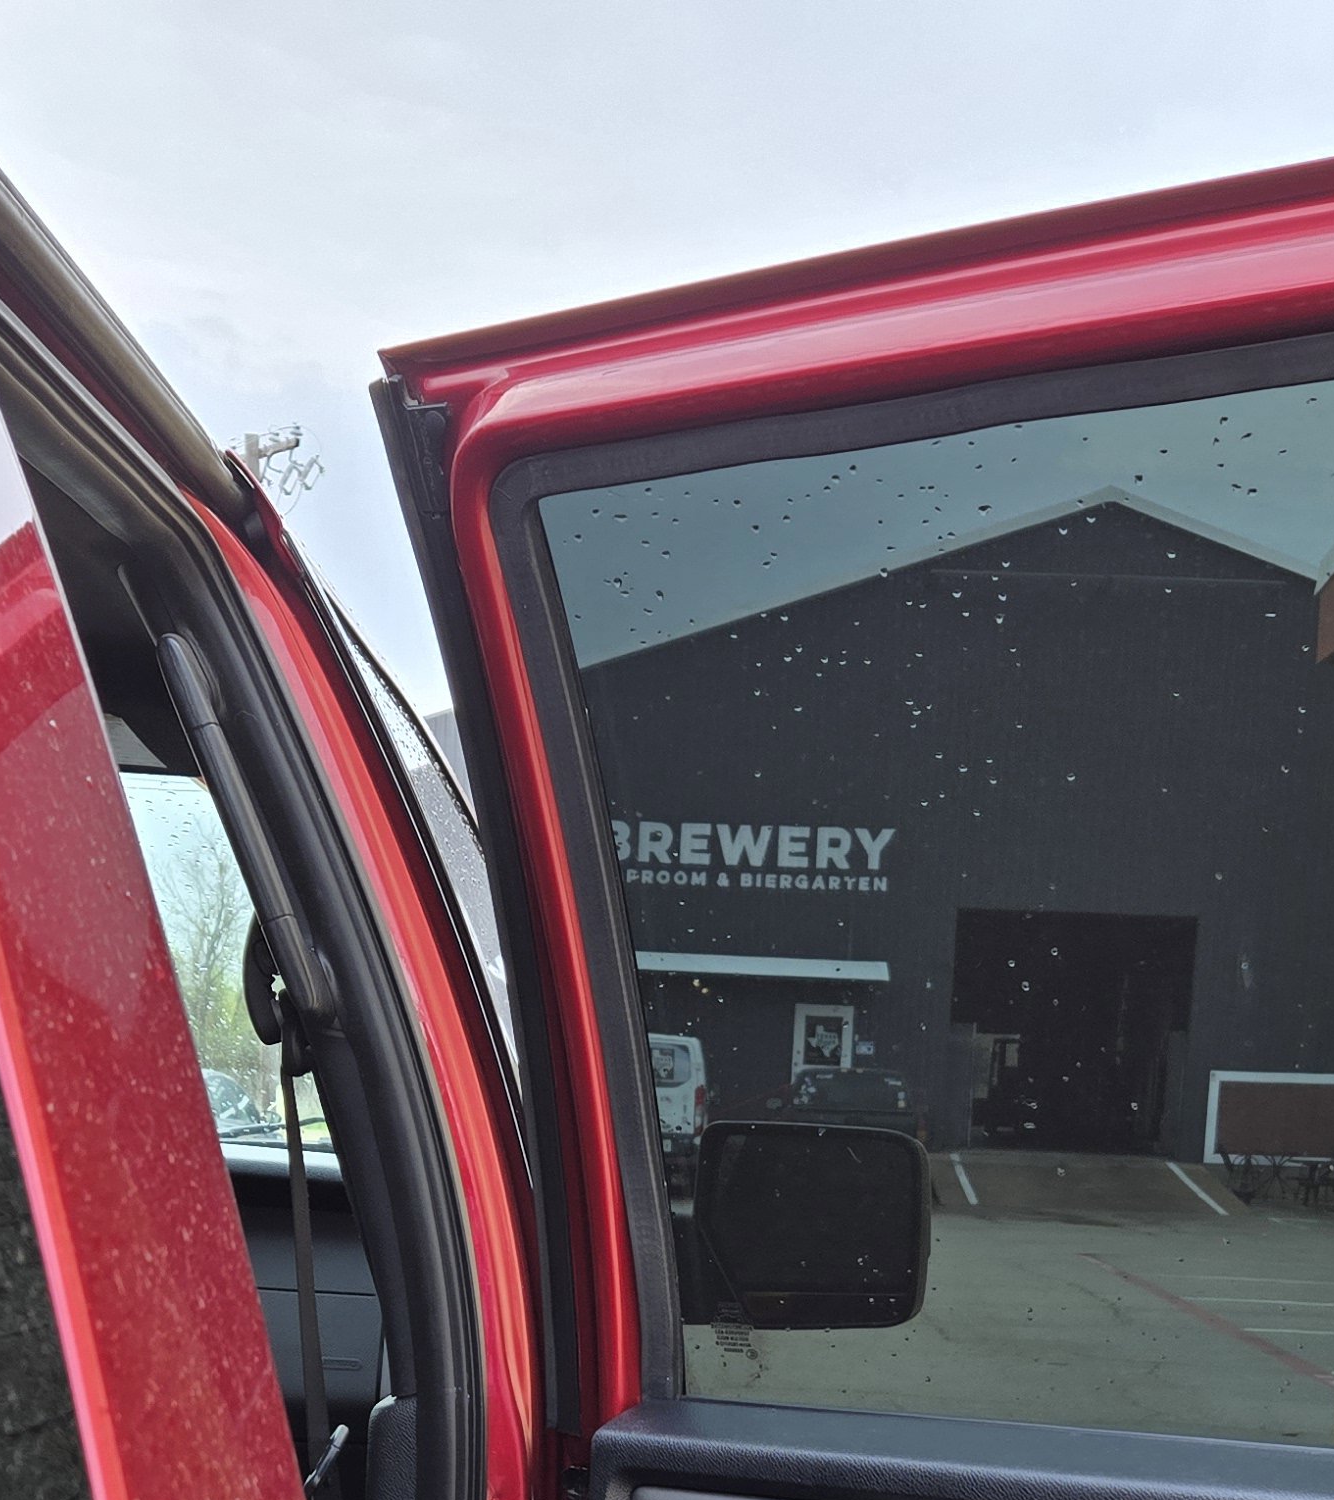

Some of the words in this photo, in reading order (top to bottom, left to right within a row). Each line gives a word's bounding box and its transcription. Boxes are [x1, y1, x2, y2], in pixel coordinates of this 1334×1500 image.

[610, 819, 896, 871] BREWERY
[716, 872, 729, 888] &
[740, 872, 888, 892] BIERGARTEN
